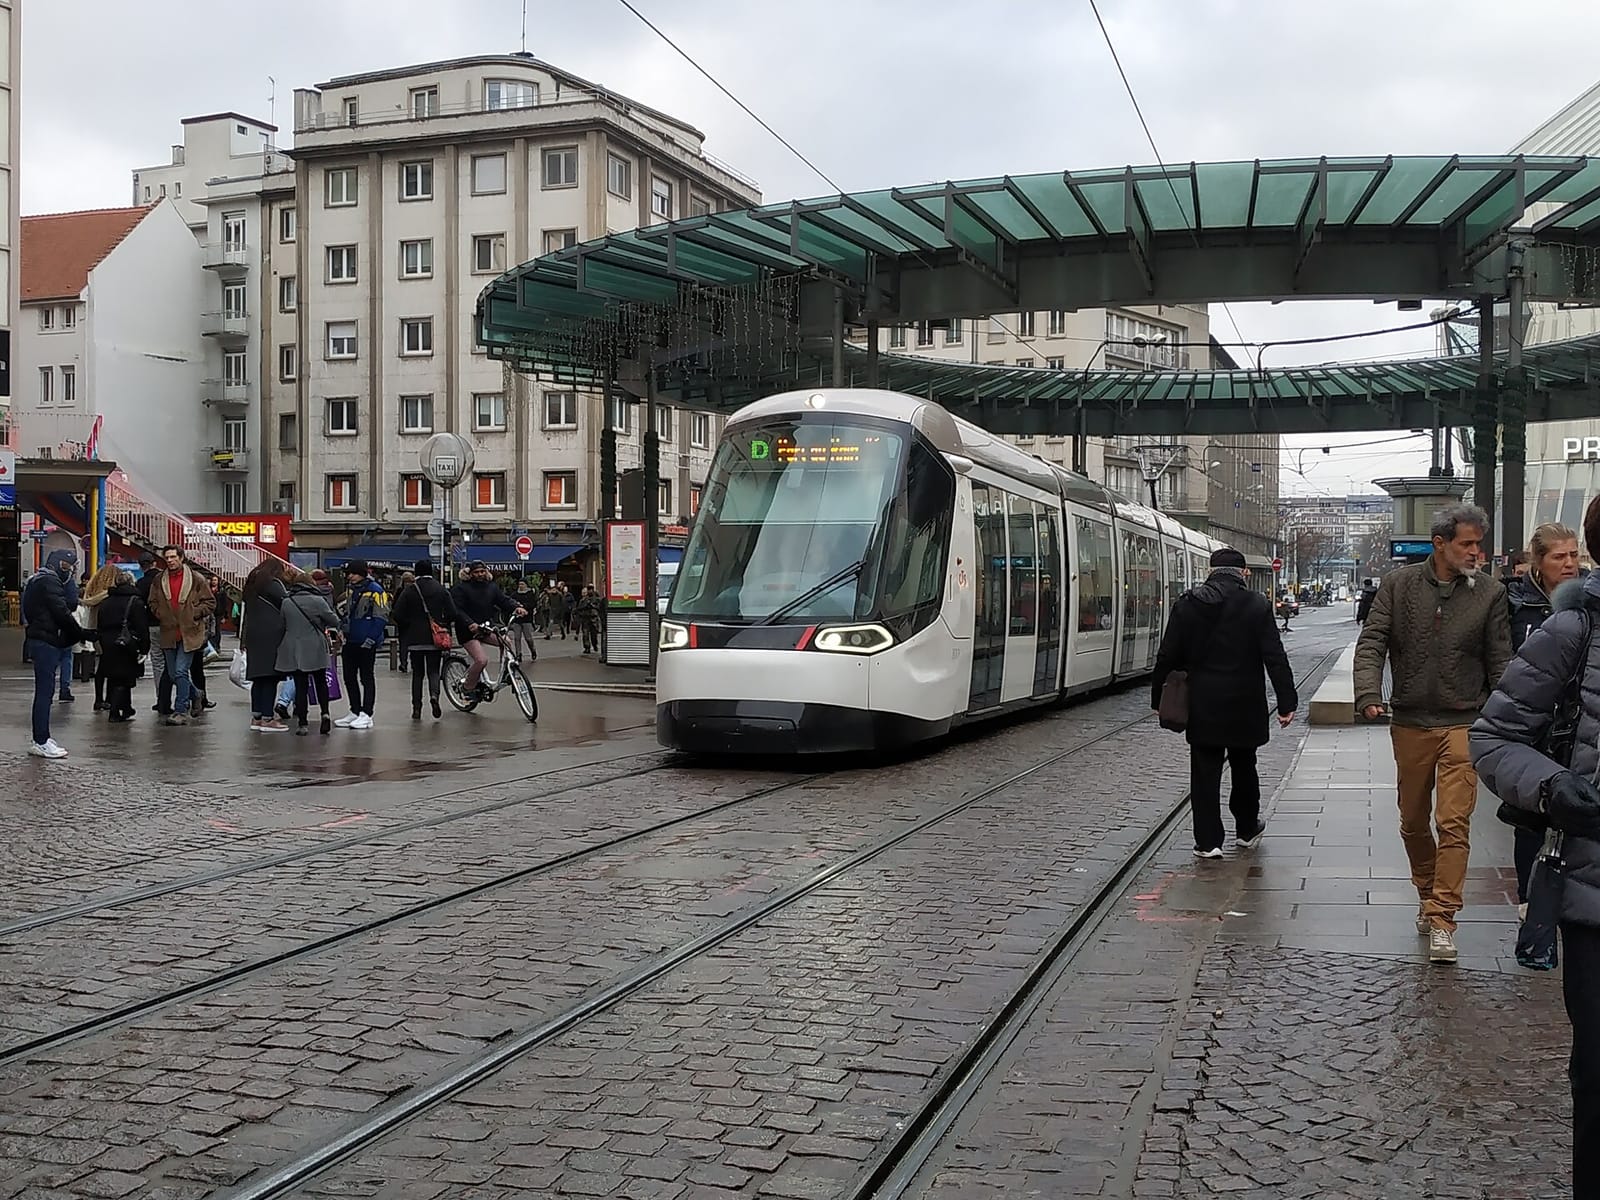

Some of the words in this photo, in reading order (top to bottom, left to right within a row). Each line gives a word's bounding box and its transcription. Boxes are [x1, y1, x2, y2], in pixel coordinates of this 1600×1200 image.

[751, 440, 769, 459] D
[1563, 436, 1600, 460] PR
[486, 563, 522, 571] STAURANT
